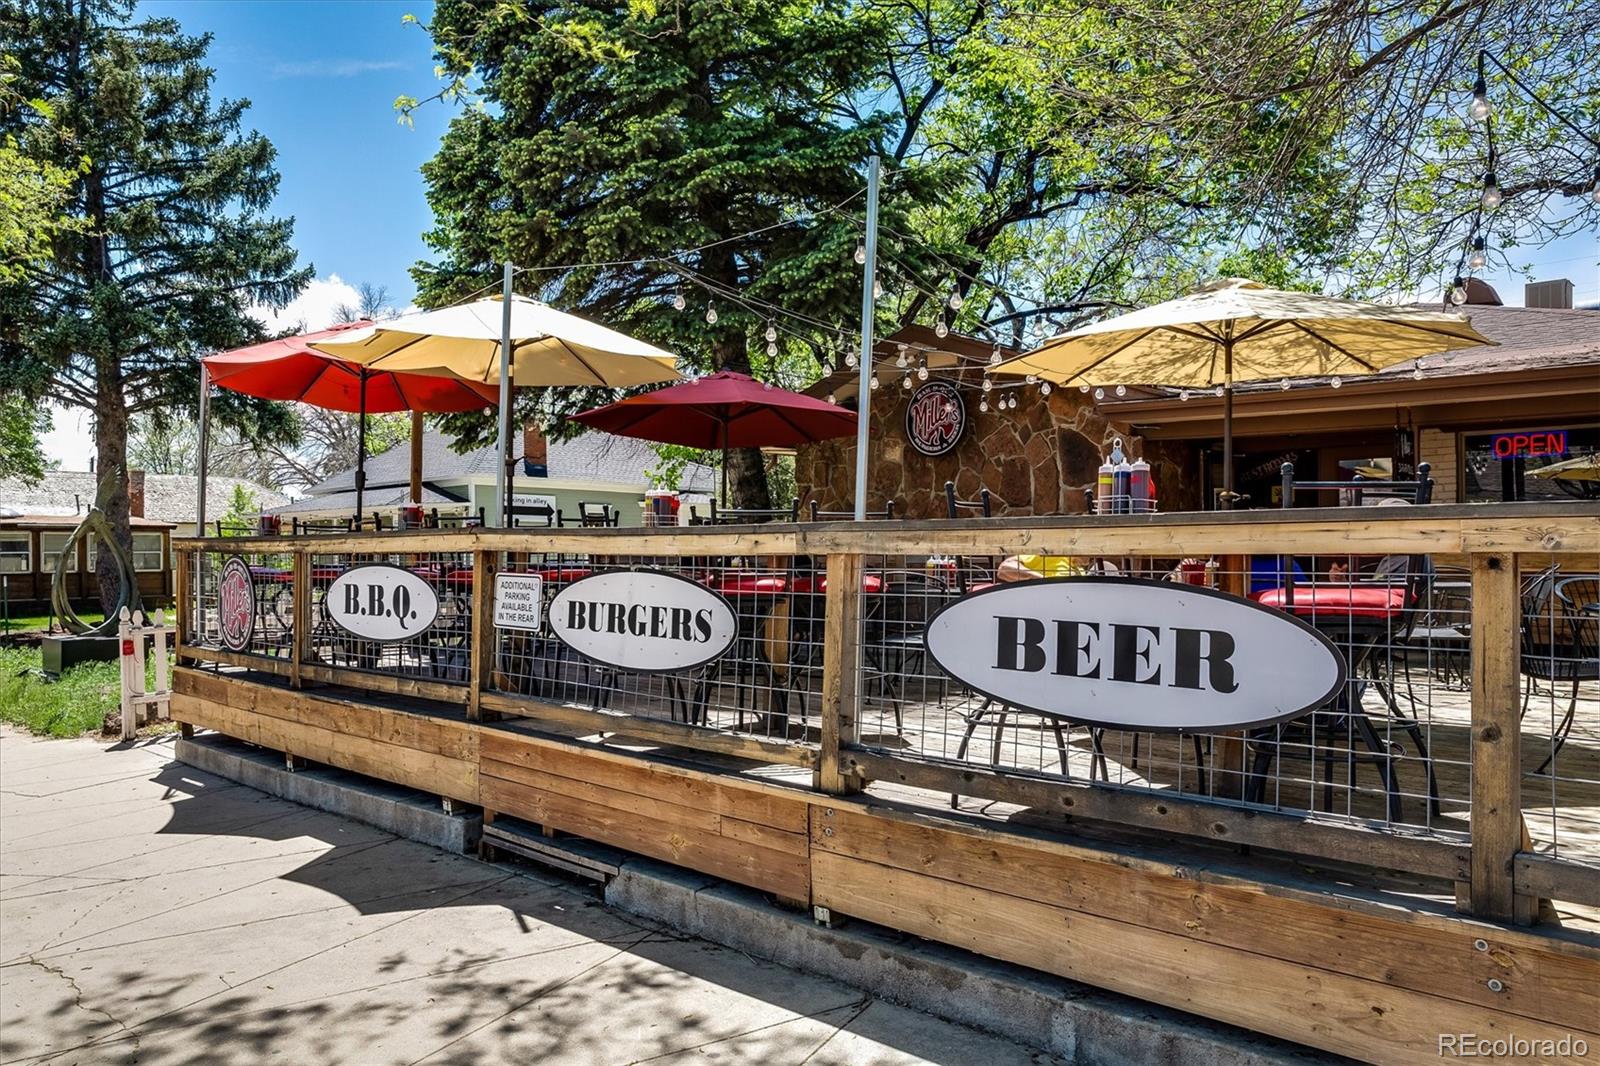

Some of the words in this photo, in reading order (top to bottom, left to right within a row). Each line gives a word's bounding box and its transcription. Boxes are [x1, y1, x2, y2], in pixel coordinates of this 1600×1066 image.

[1495, 432, 1565, 457] OPEN
[501, 581, 535, 591] ADDITIONAL
[505, 591, 531, 601] PARKING
[343, 583, 417, 630] B.B.Q.
[501, 602, 533, 612] AVAILABLE
[498, 612, 504, 620] IN
[505, 612, 517, 621] THE
[518, 613, 535, 622] REAR
[566, 600, 713, 643] BURGERS
[991, 615, 1240, 694] BEER
